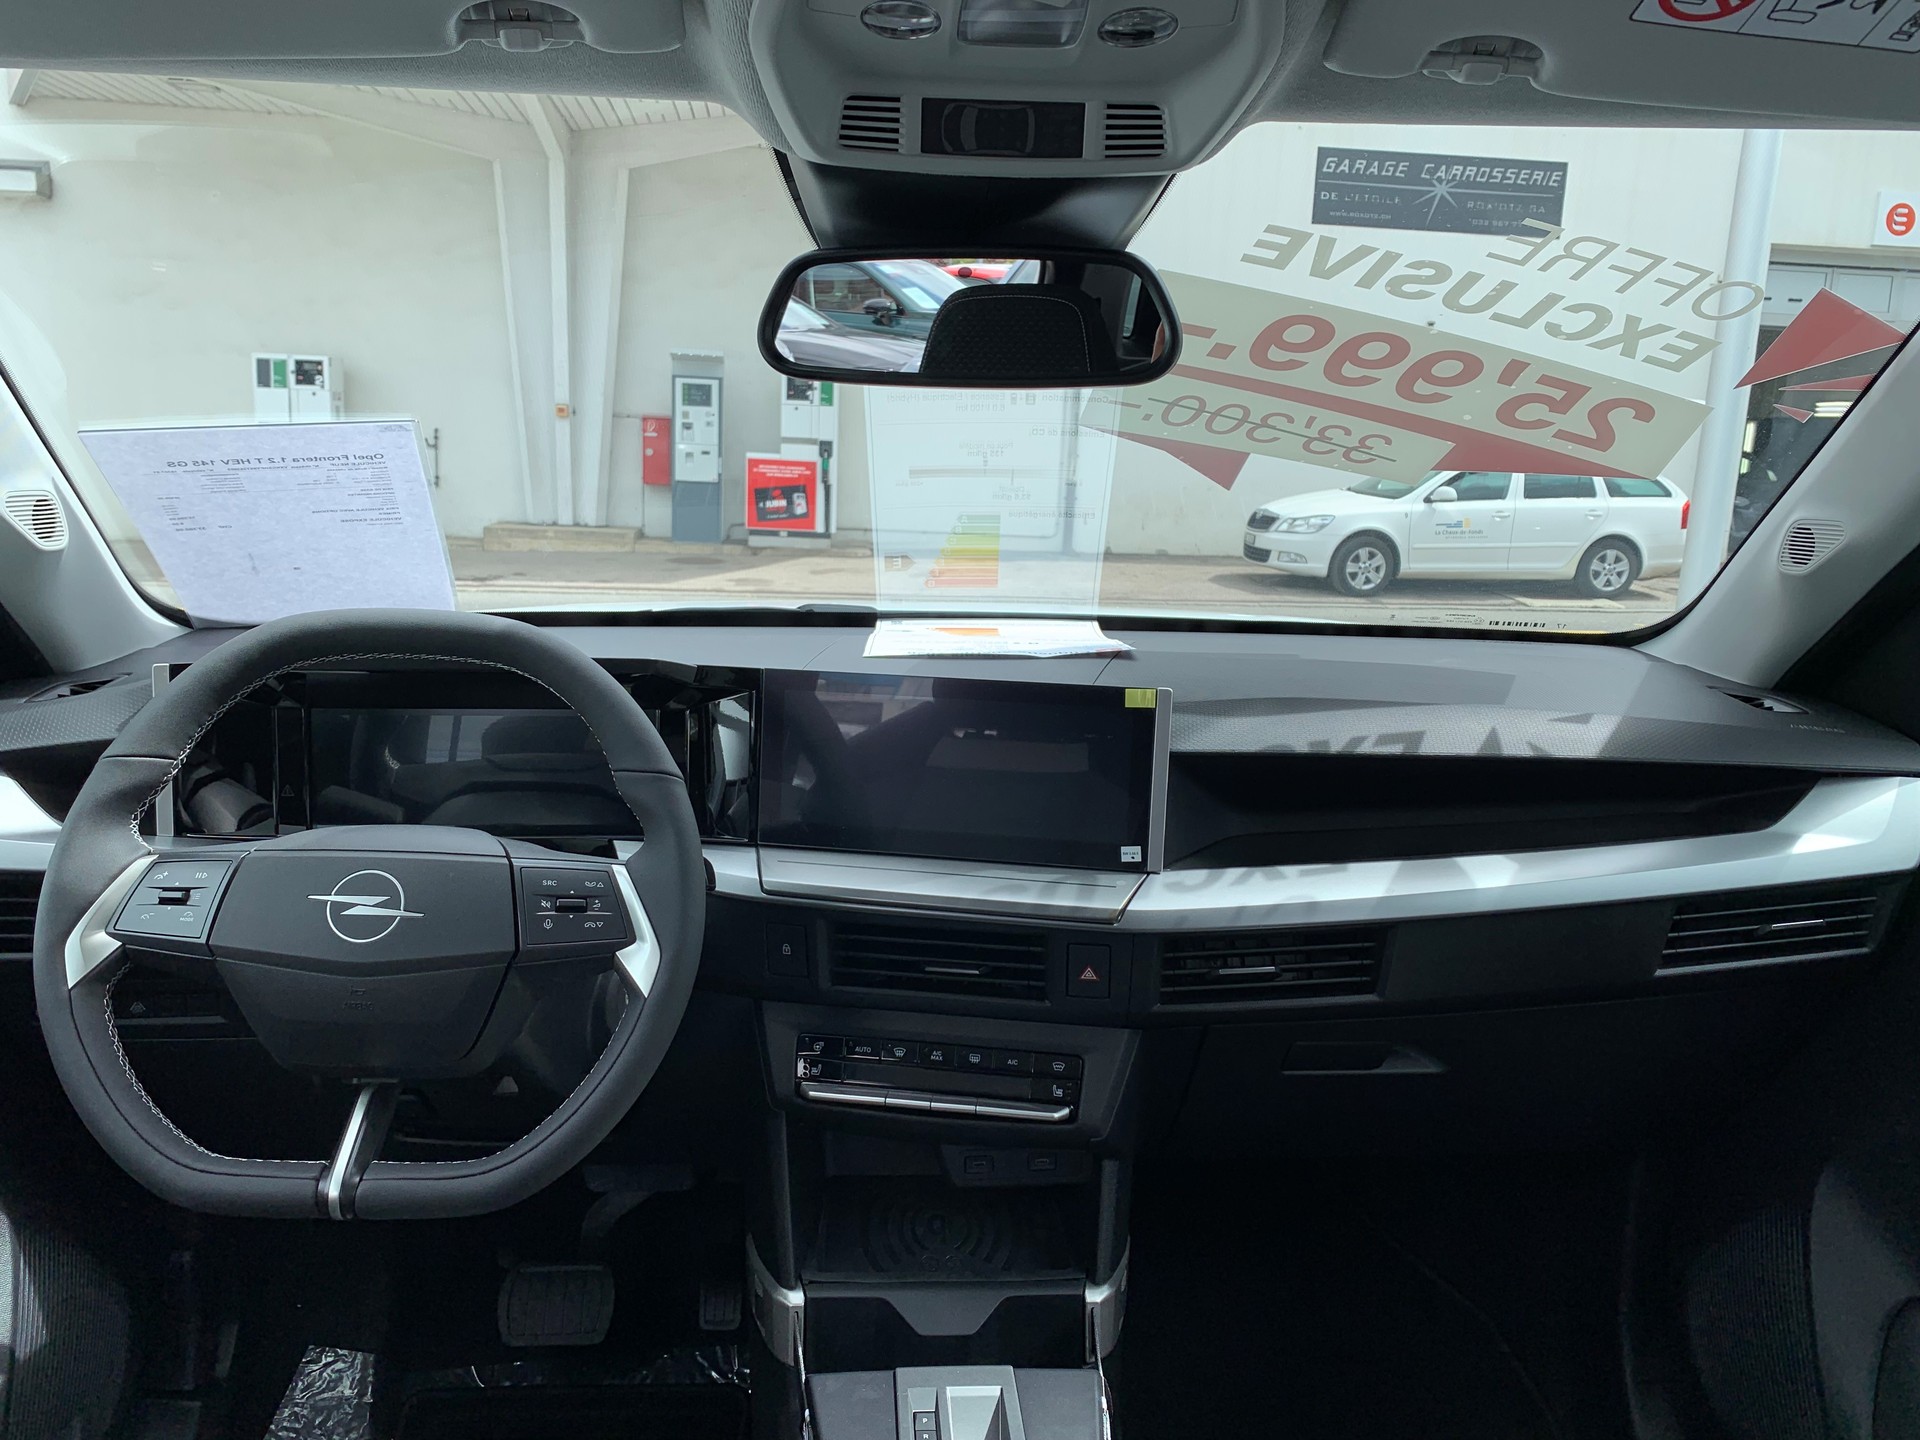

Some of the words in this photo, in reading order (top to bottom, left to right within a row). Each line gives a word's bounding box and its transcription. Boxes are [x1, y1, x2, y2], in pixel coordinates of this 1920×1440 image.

[1322, 157, 1410, 177] GARAGE
[1421, 163, 1563, 187] CARROSSERIE
[1321, 191, 1338, 200] DE
[542, 879, 558, 887] SRC
[854, 1045, 872, 1054] AUTO
[930, 1054, 943, 1062] MAX
[1007, 1058, 1018, 1066] A/C
